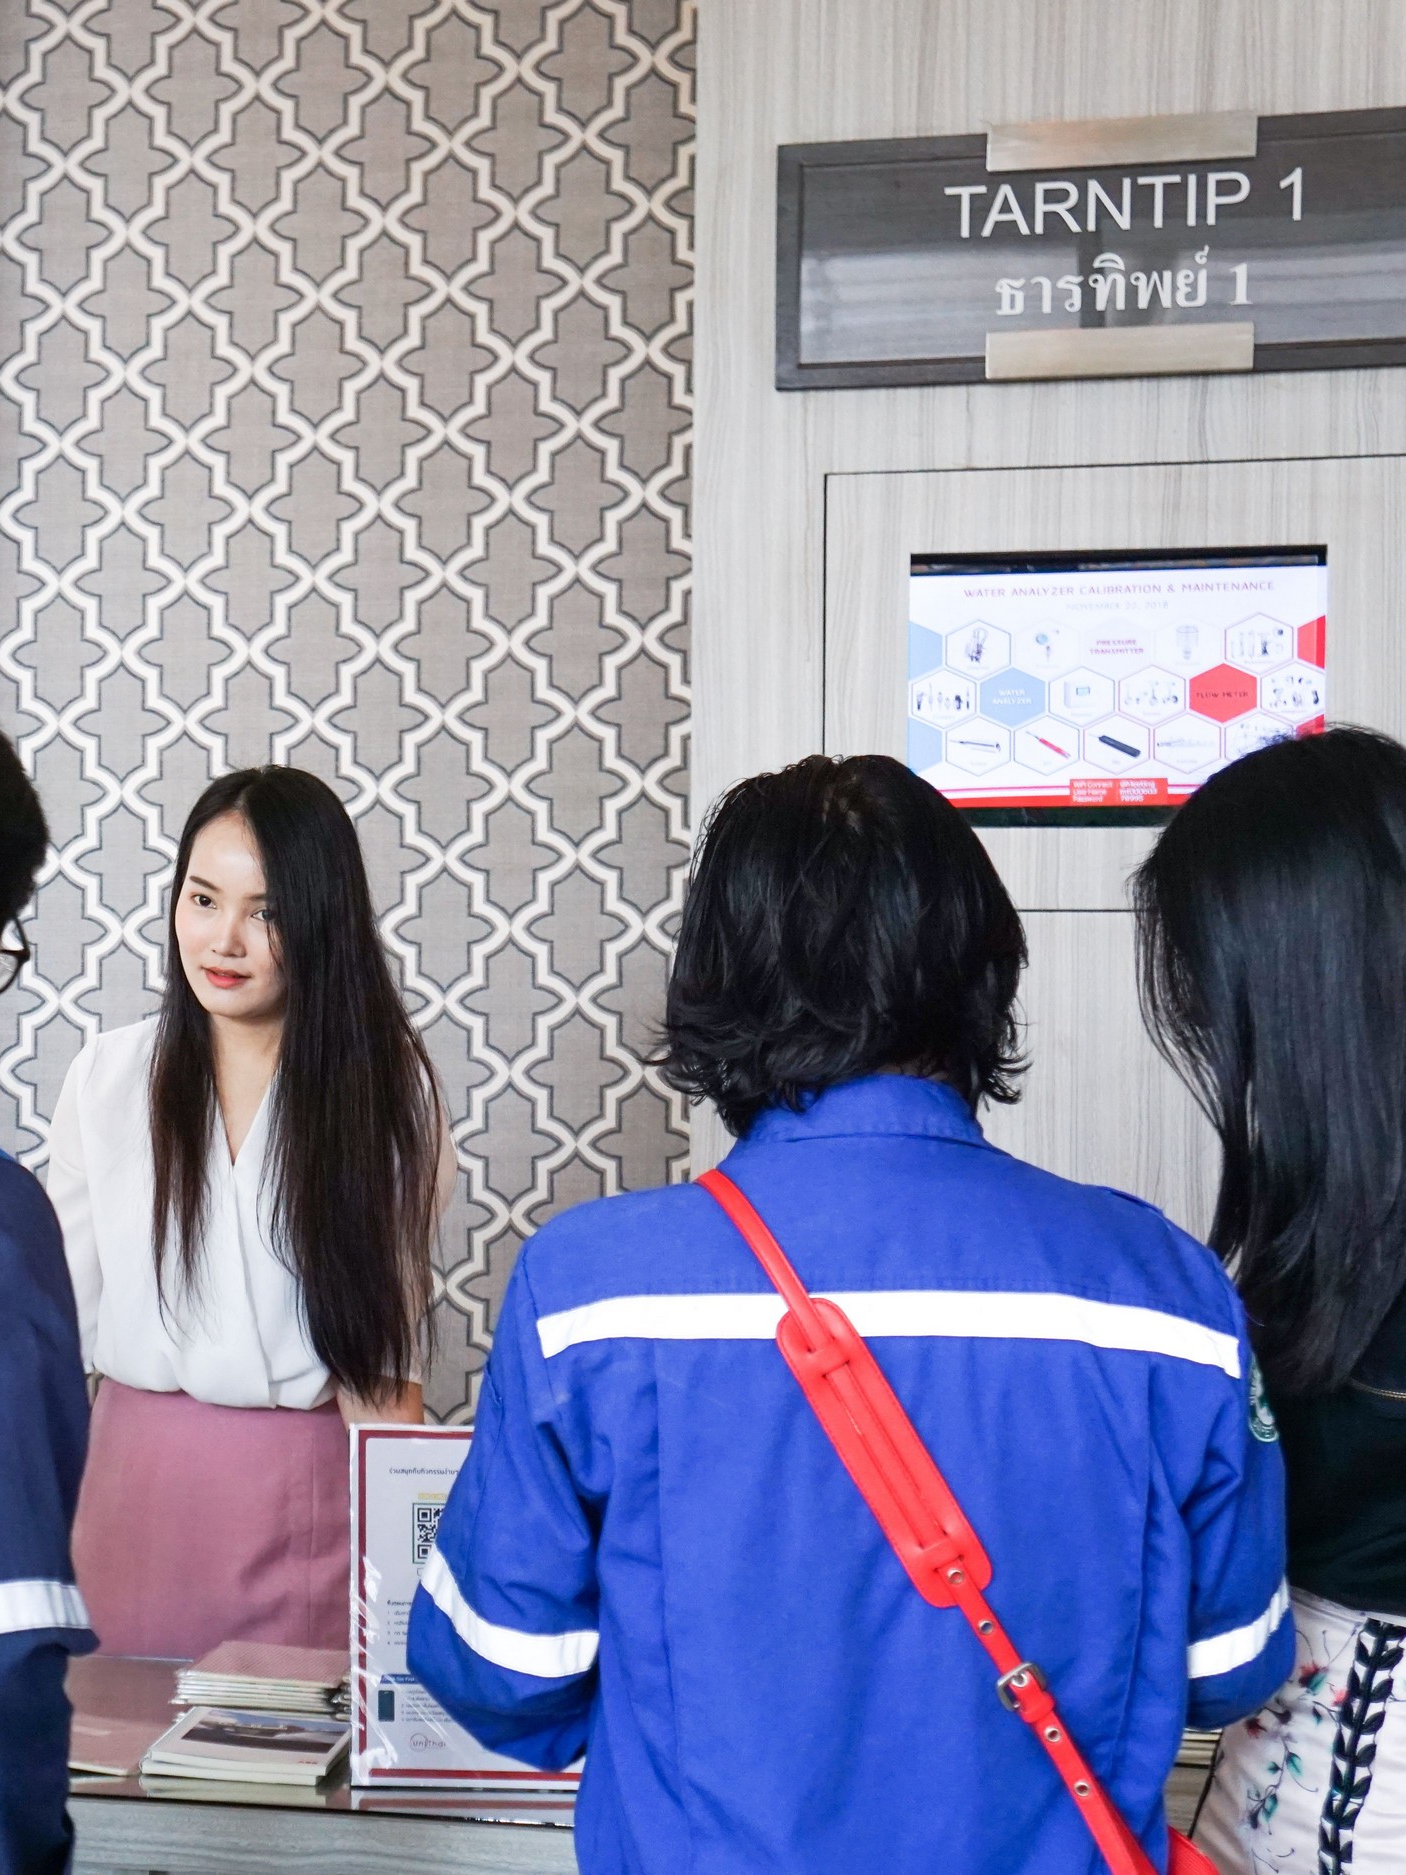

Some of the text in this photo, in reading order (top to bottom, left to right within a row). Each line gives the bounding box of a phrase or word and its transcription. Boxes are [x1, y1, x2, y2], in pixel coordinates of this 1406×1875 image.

[944, 166, 1303, 239] TARNTIP 1
[995, 244, 1254, 316] ธารทิพย์ 1
[963, 581, 1275, 598] WATER ANALYZER CALIBRATION & MAINTENANCE
[992, 697, 1033, 705] ANALYZER
[998, 689, 1026, 697] WATER
